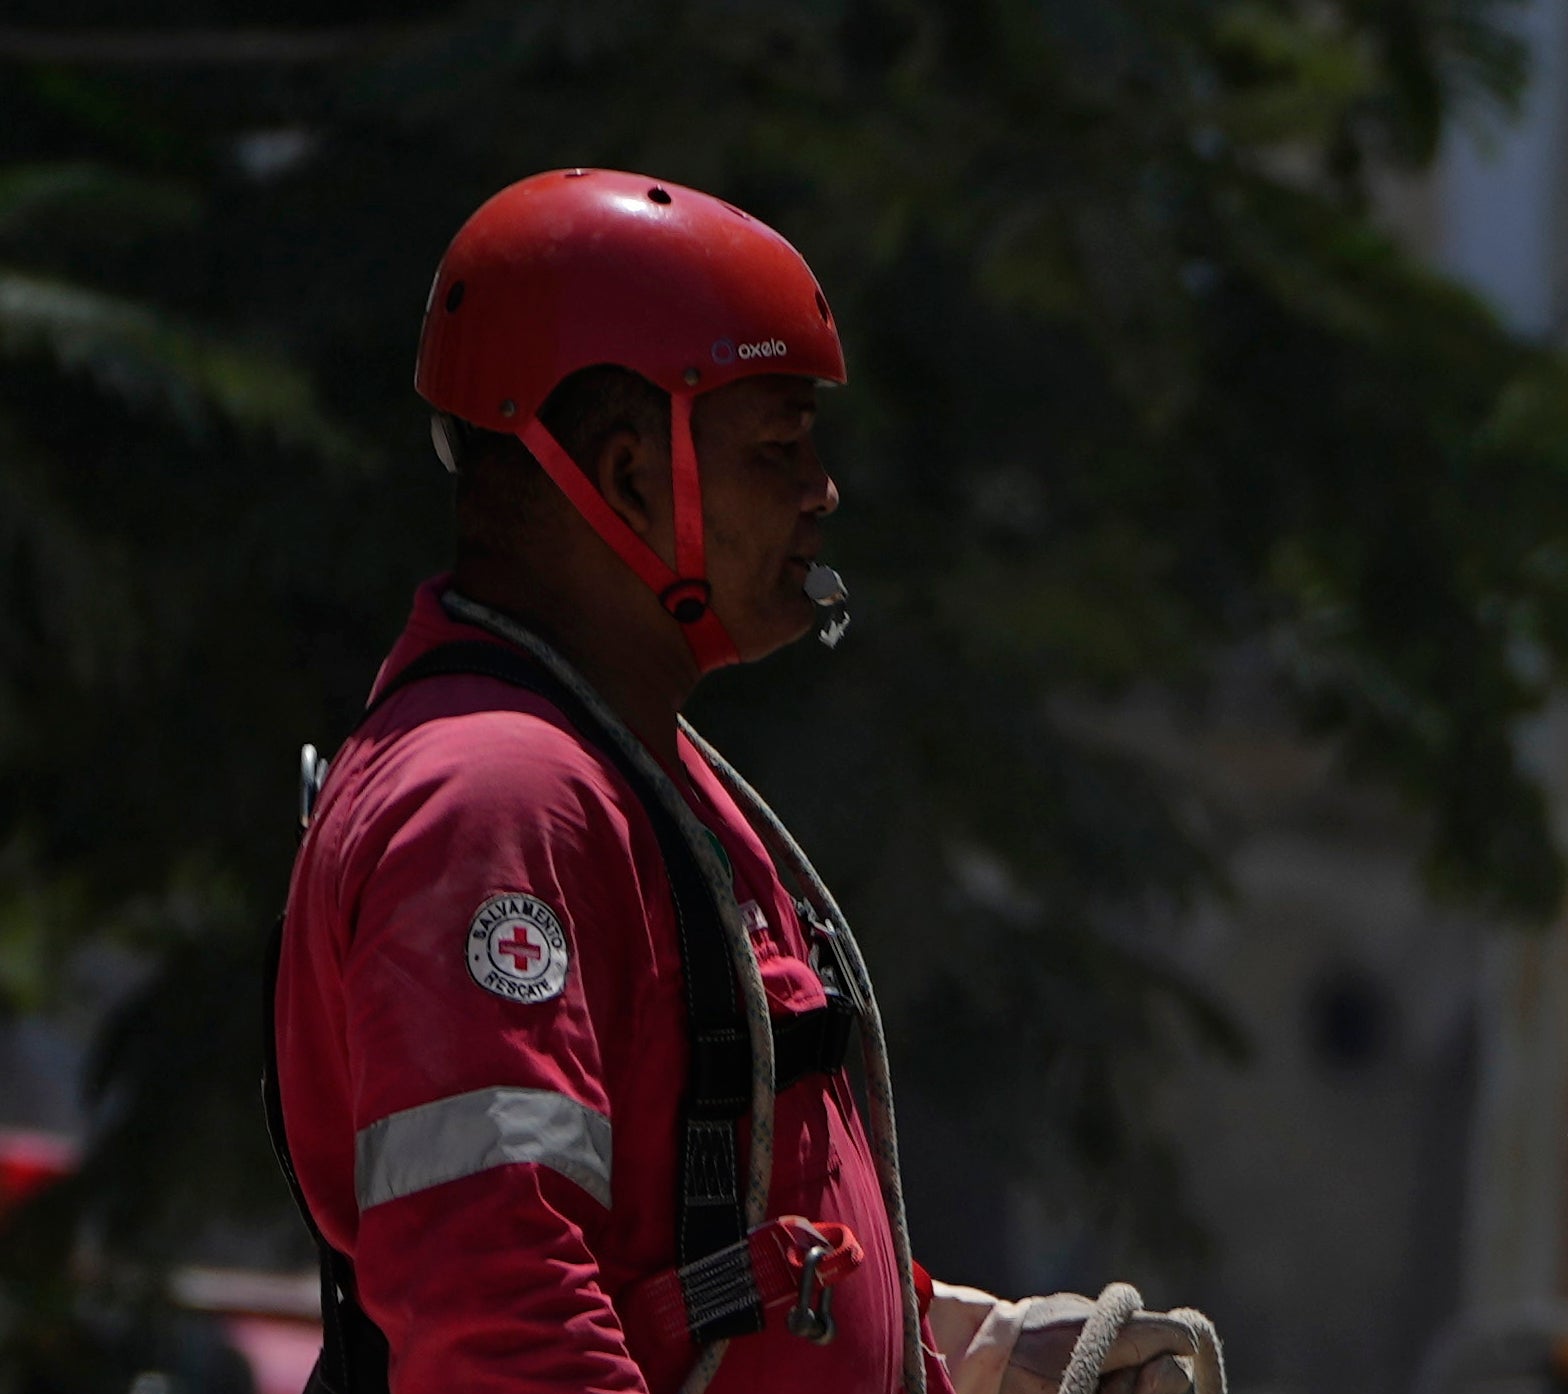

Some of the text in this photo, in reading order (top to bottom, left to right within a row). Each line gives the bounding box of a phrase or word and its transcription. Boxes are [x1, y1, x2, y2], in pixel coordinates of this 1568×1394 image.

[738, 337, 788, 360] oxelo
[473, 900, 563, 948] SALVAMENTO
[484, 971, 552, 998] RESCATE
